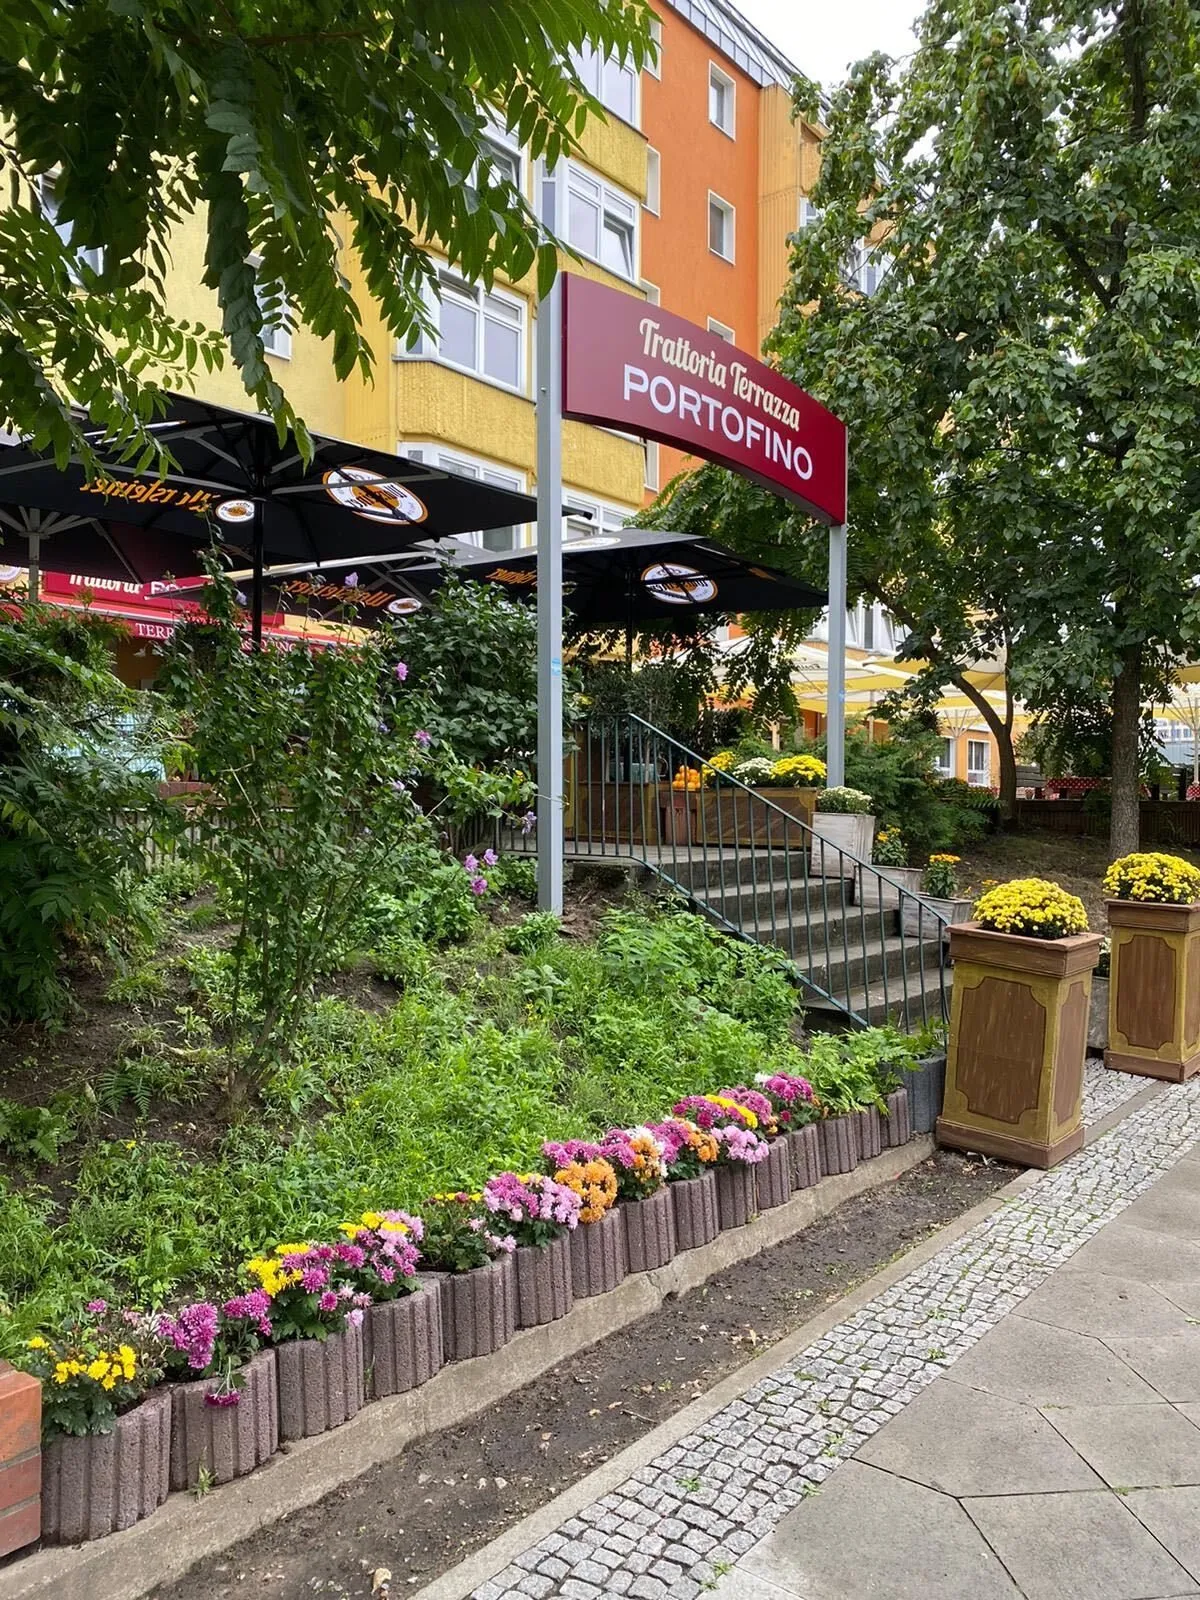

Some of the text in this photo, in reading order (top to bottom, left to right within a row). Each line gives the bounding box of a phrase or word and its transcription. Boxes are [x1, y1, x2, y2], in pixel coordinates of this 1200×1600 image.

[623, 363, 813, 481] PORTOFINO
[639, 318, 801, 432] Trattoria Terrazza
[136, 623, 178, 642] TERR
